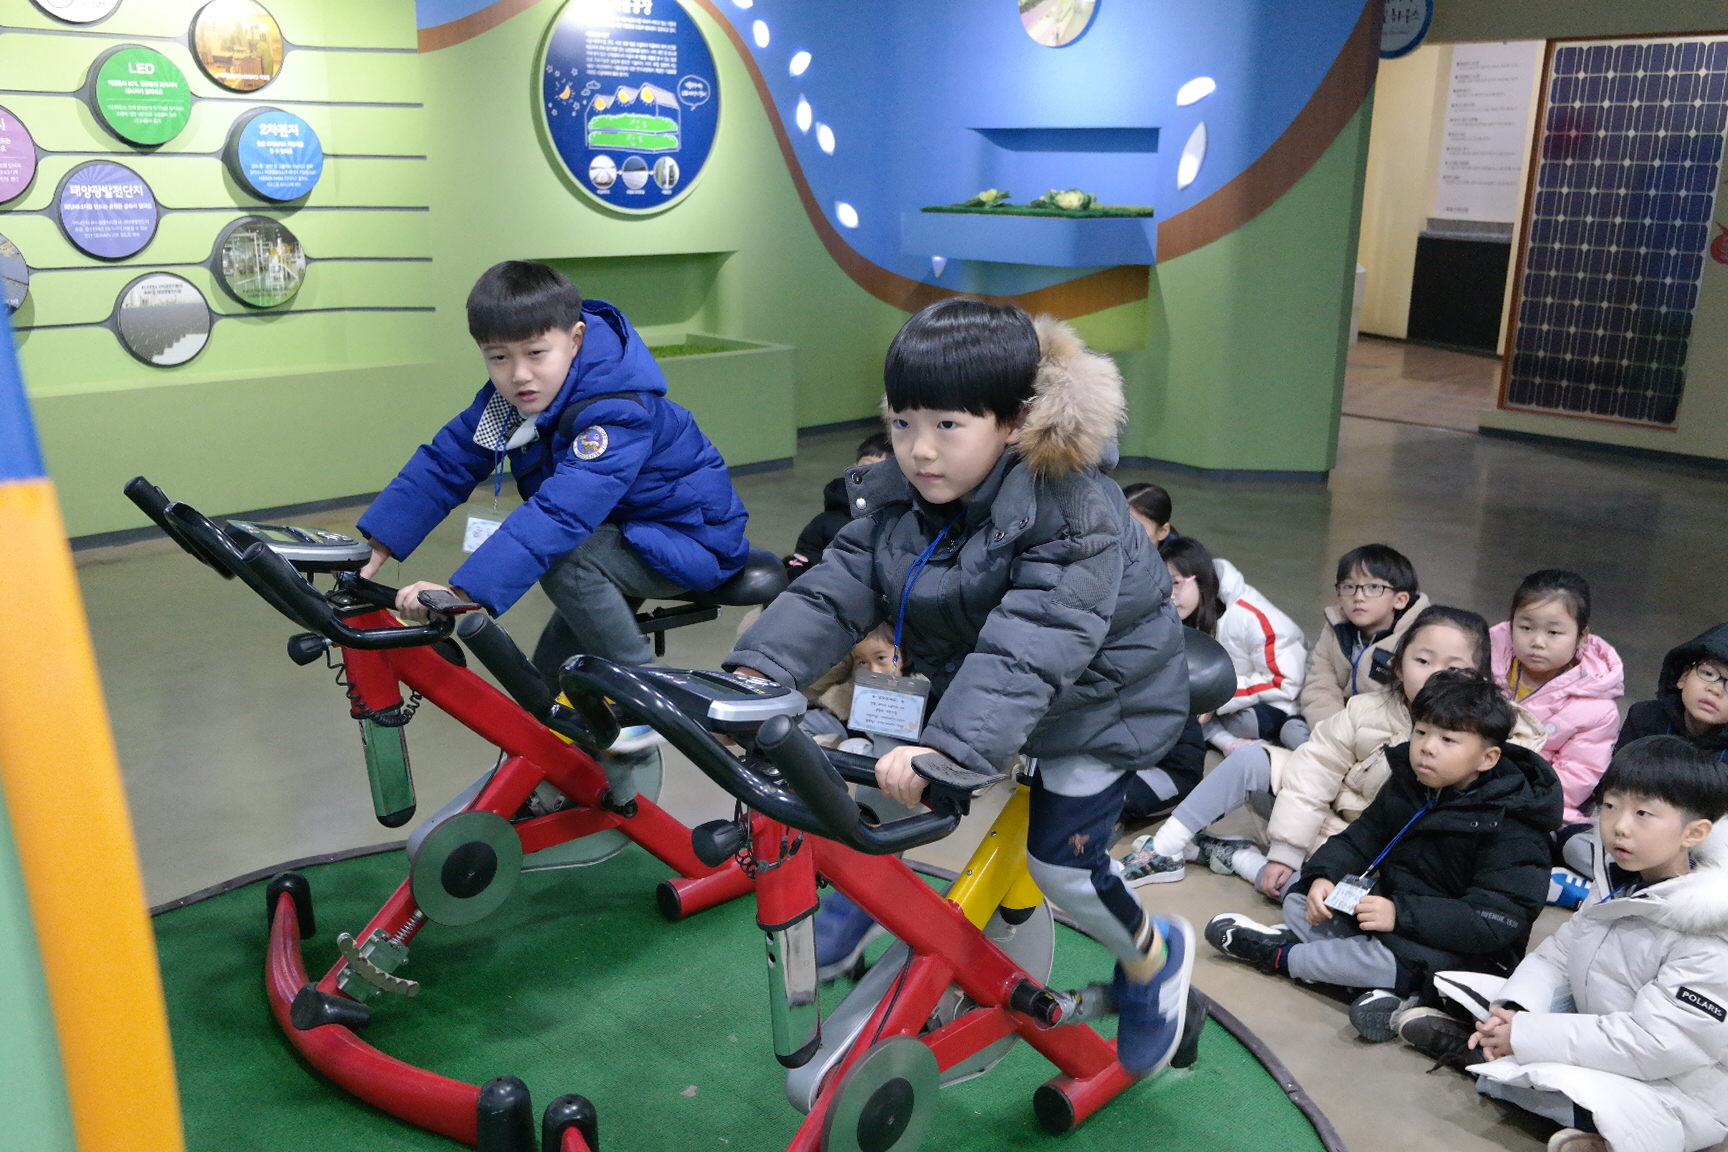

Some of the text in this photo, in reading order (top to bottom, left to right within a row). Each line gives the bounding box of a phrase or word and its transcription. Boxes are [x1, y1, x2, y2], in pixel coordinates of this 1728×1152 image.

[128, 61, 155, 74] LED
[259, 123, 299, 138] 2차전지
[69, 184, 144, 199] 태양광발전단지
[1681, 990, 1722, 1017] POLARIS
